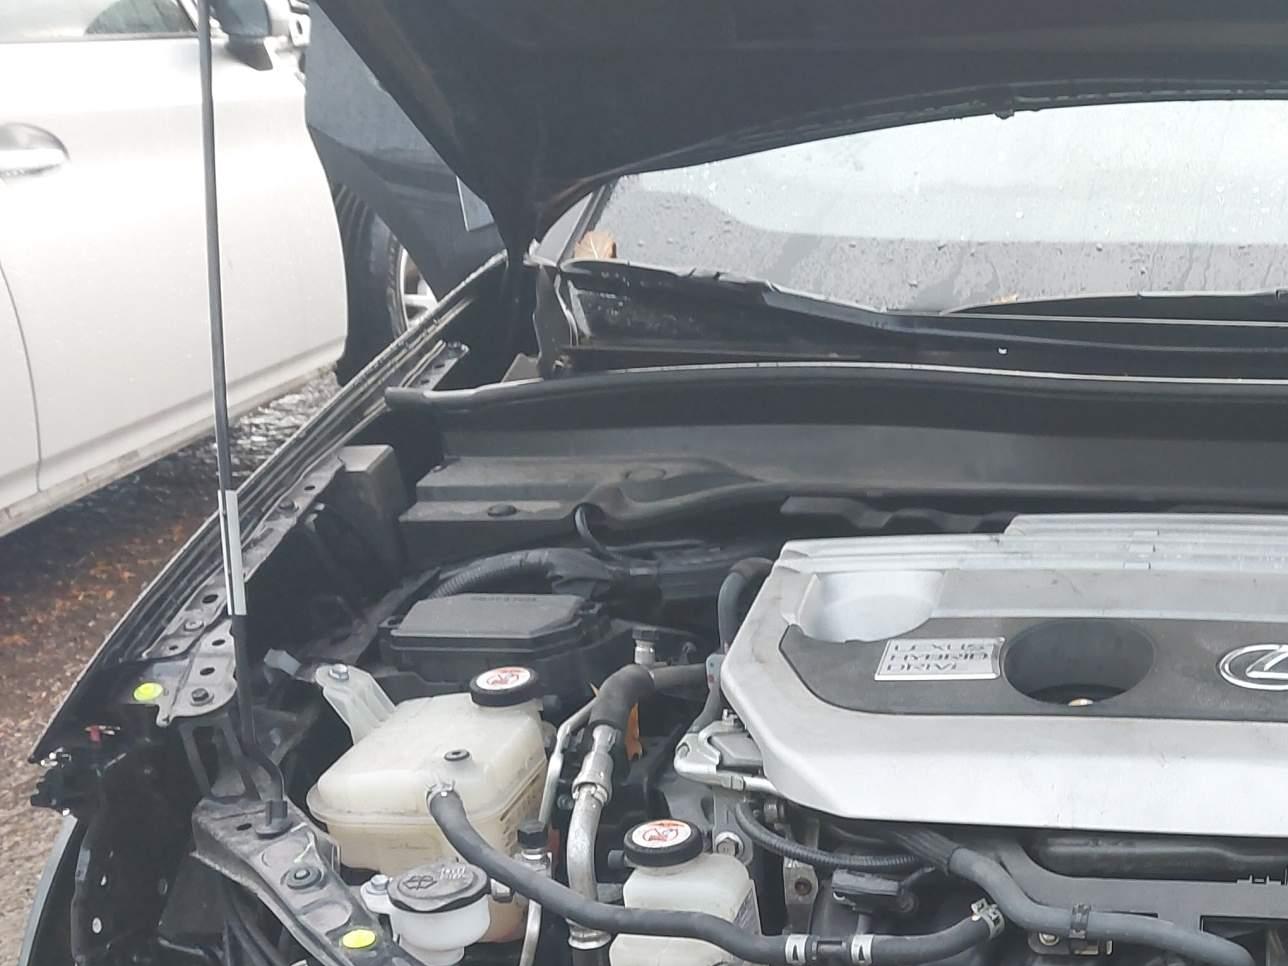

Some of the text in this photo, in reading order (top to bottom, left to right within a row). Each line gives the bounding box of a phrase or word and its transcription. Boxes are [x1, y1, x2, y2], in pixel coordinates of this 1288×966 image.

[892, 643, 987, 652] LEXUS
[888, 653, 990, 662] HYBRID
[885, 663, 963, 671] DRIVE
